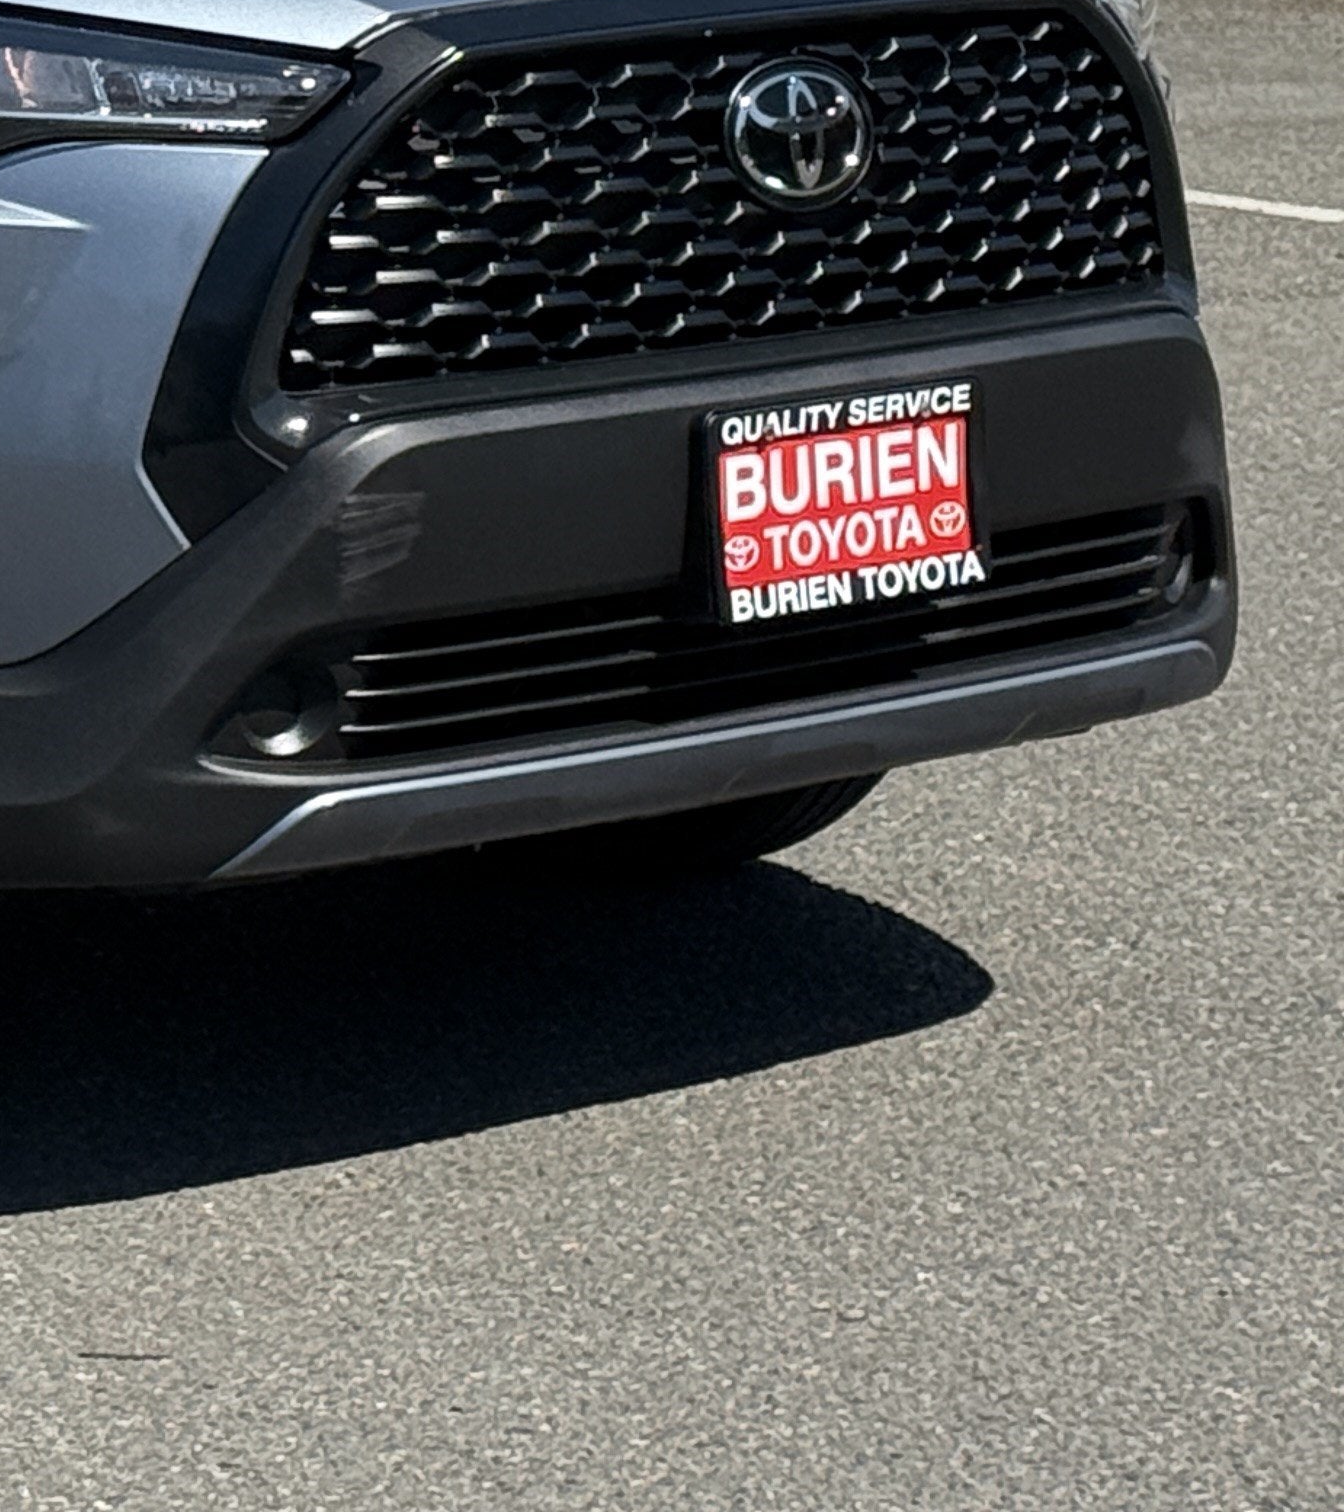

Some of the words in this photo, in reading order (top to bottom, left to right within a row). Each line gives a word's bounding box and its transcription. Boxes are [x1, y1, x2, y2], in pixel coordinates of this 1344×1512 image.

[721, 401, 844, 446] QUALITY
[848, 383, 972, 427] SERVICE
[724, 421, 960, 523] BURIEN
[763, 504, 928, 570] TOYOTA
[730, 570, 853, 623] BURIEN
[857, 550, 985, 600] TOYOTA
